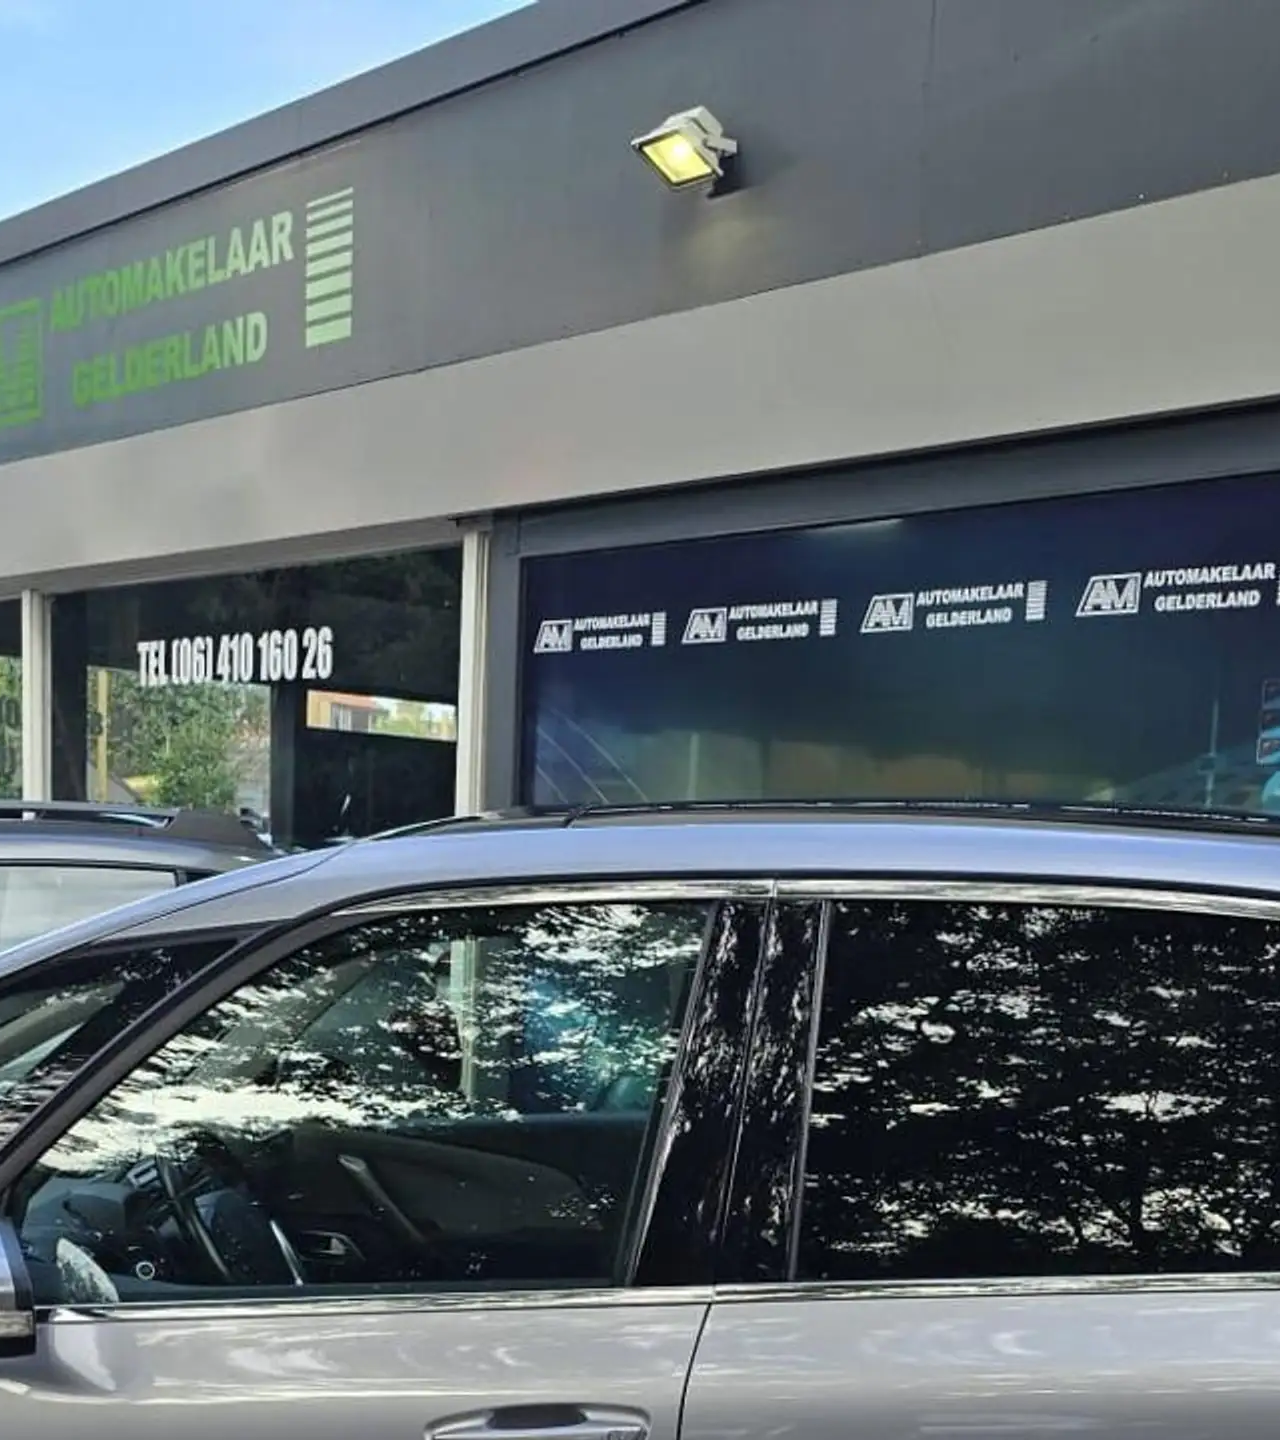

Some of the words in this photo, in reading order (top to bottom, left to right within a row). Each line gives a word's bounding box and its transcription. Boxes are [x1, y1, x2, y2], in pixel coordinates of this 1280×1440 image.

[50, 211, 295, 333] AUTOMAKELAAR
[72, 312, 268, 409] GELDERLAND
[1144, 563, 1275, 588] AUTOMAKELAAR
[917, 582, 1024, 606] AUTOMAKELAAR
[1082, 577, 1140, 613] AM
[1154, 590, 1260, 612] GELDERLAND
[574, 613, 650, 631] AUTOMAKELAAR
[728, 601, 818, 620] AUTOMAKELAAR
[864, 597, 913, 630] AM
[925, 608, 1012, 628] GELDERLAND
[688, 612, 725, 640] AM
[736, 623, 809, 640] GELDERLAND
[580, 634, 643, 650] GELDERLAND
[137, 640, 168, 687] TEL
[172, 636, 213, 685] (06)
[217, 632, 253, 684] 410
[257, 628, 297, 682] 160
[302, 626, 334, 680] 26
